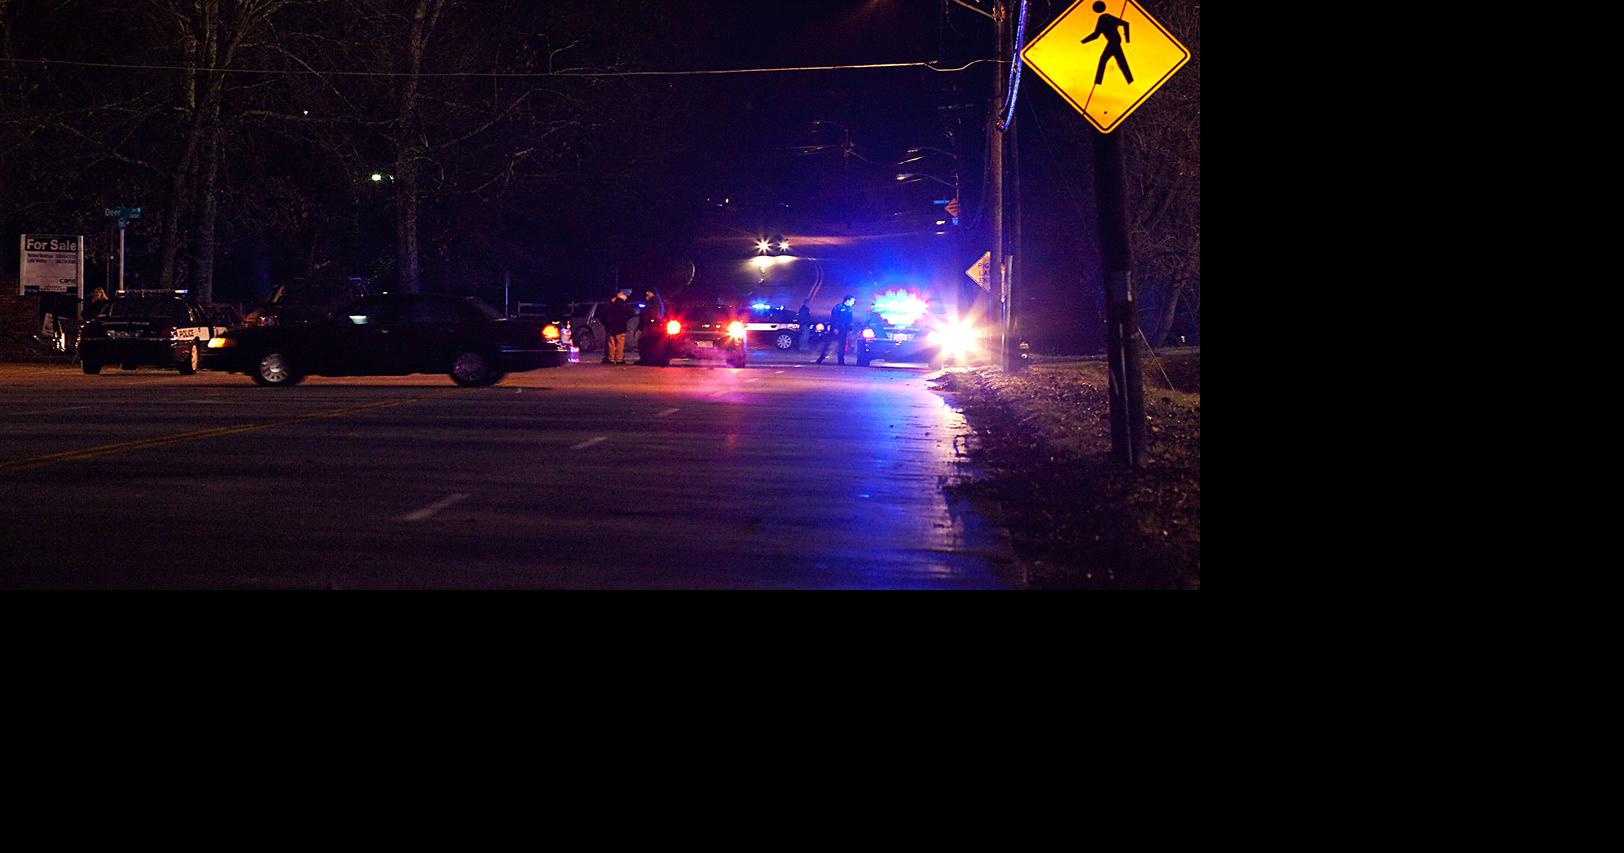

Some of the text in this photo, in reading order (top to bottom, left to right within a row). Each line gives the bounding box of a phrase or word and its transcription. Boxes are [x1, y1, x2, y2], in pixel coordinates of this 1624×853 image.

[26, 238, 77, 251] For Sale
[179, 329, 195, 339] POLICE
